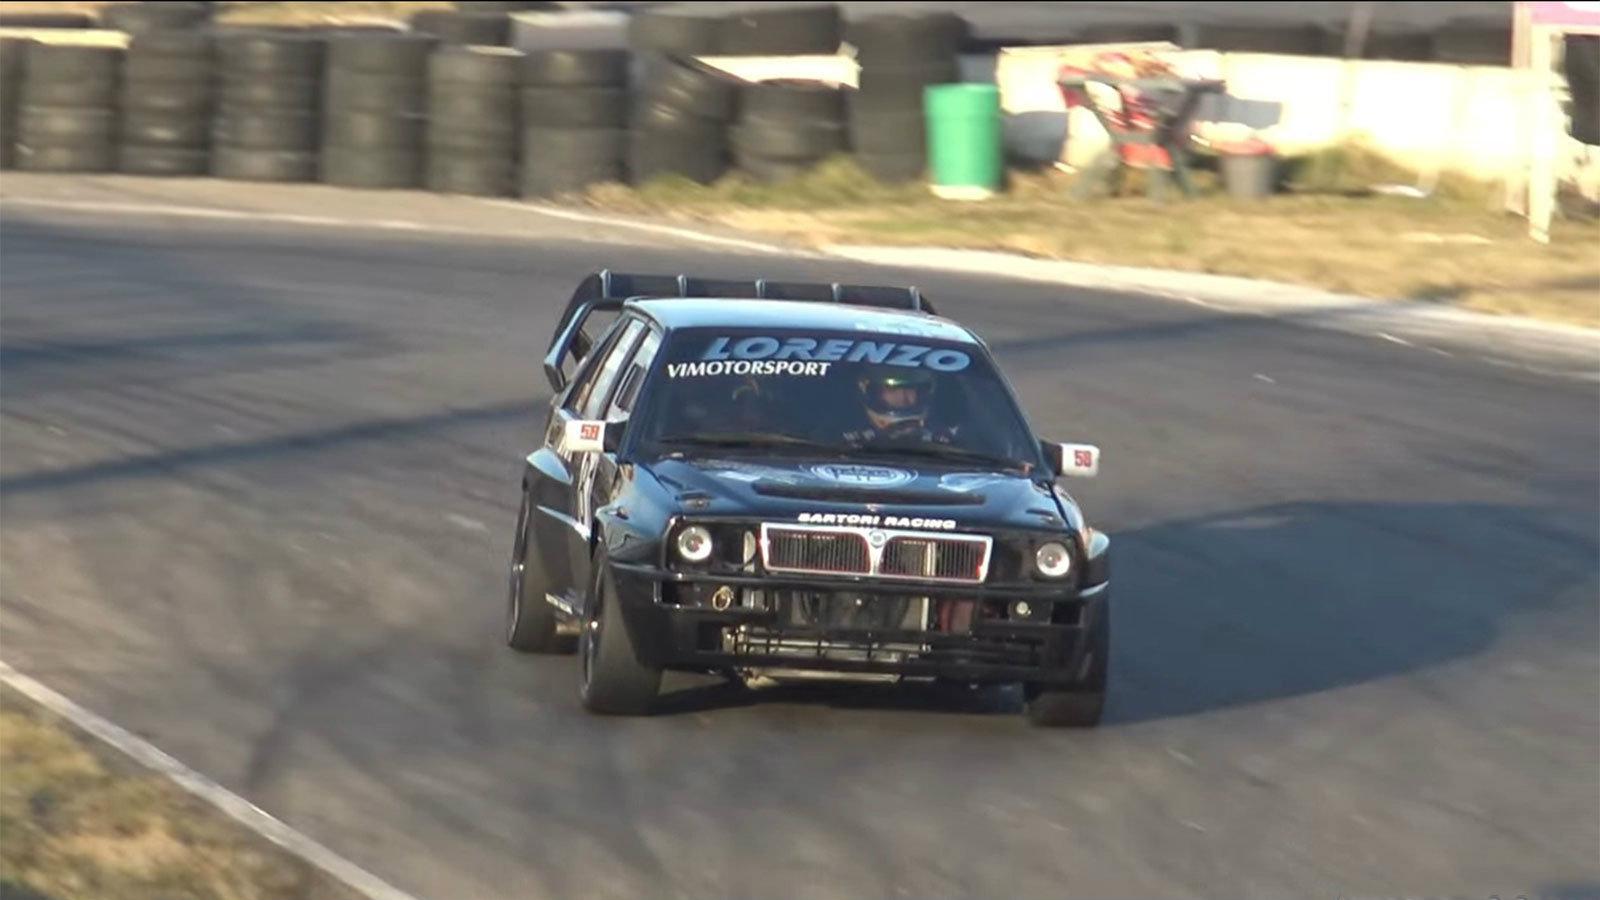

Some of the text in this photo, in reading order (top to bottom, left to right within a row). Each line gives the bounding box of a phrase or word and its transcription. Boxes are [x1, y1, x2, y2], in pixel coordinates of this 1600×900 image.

[704, 335, 971, 372] LORENZO
[666, 360, 832, 379] VIMOTORSPORT
[798, 512, 957, 529] SARTORI RACING
